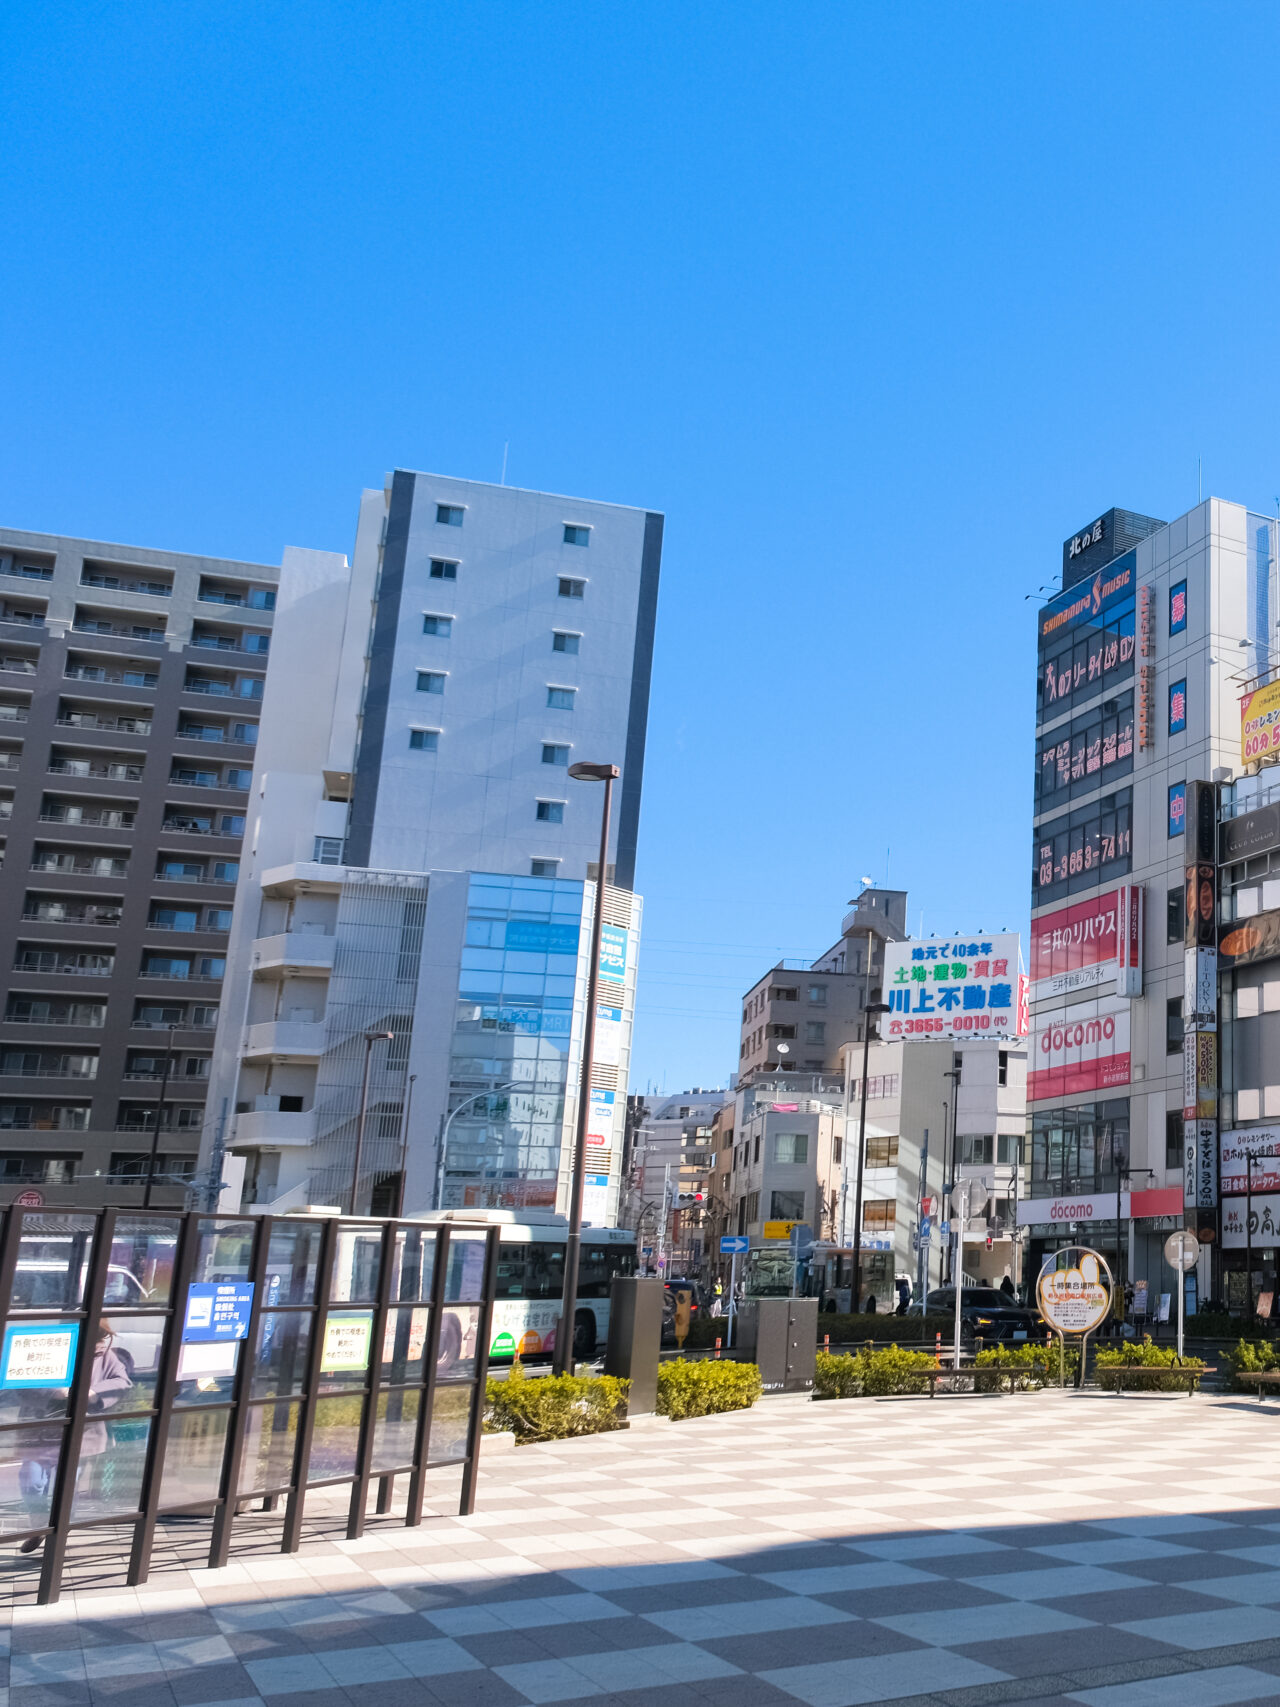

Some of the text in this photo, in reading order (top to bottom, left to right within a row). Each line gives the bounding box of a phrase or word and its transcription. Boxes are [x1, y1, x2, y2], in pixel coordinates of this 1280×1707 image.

[1170, 591, 1185, 825] 募 集 中
[1245, 732, 1268, 757] 60分
[1039, 830, 1130, 886] 03-3653-7411
[1041, 845, 1052, 858] TEL
[1042, 910, 1116, 955] 三井のリハウス
[911, 943, 993, 960] 地元で40余年
[1053, 968, 1104, 991] 三井不動産リアルティ
[888, 983, 1011, 1014] 川上不動産
[1201, 972, 1211, 1013] TOKYO
[904, 1015, 990, 1033] 3655-0010
[1041, 1016, 1114, 1054] docomo
[1200, 1130, 1213, 1169] 中華そば
[1223, 1178, 1231, 1190] 2F
[1051, 1201, 1093, 1219] docomo
[1049, 1282, 1095, 1290] 一時集合場所
[27, 1352, 51, 1361] 絶対に
